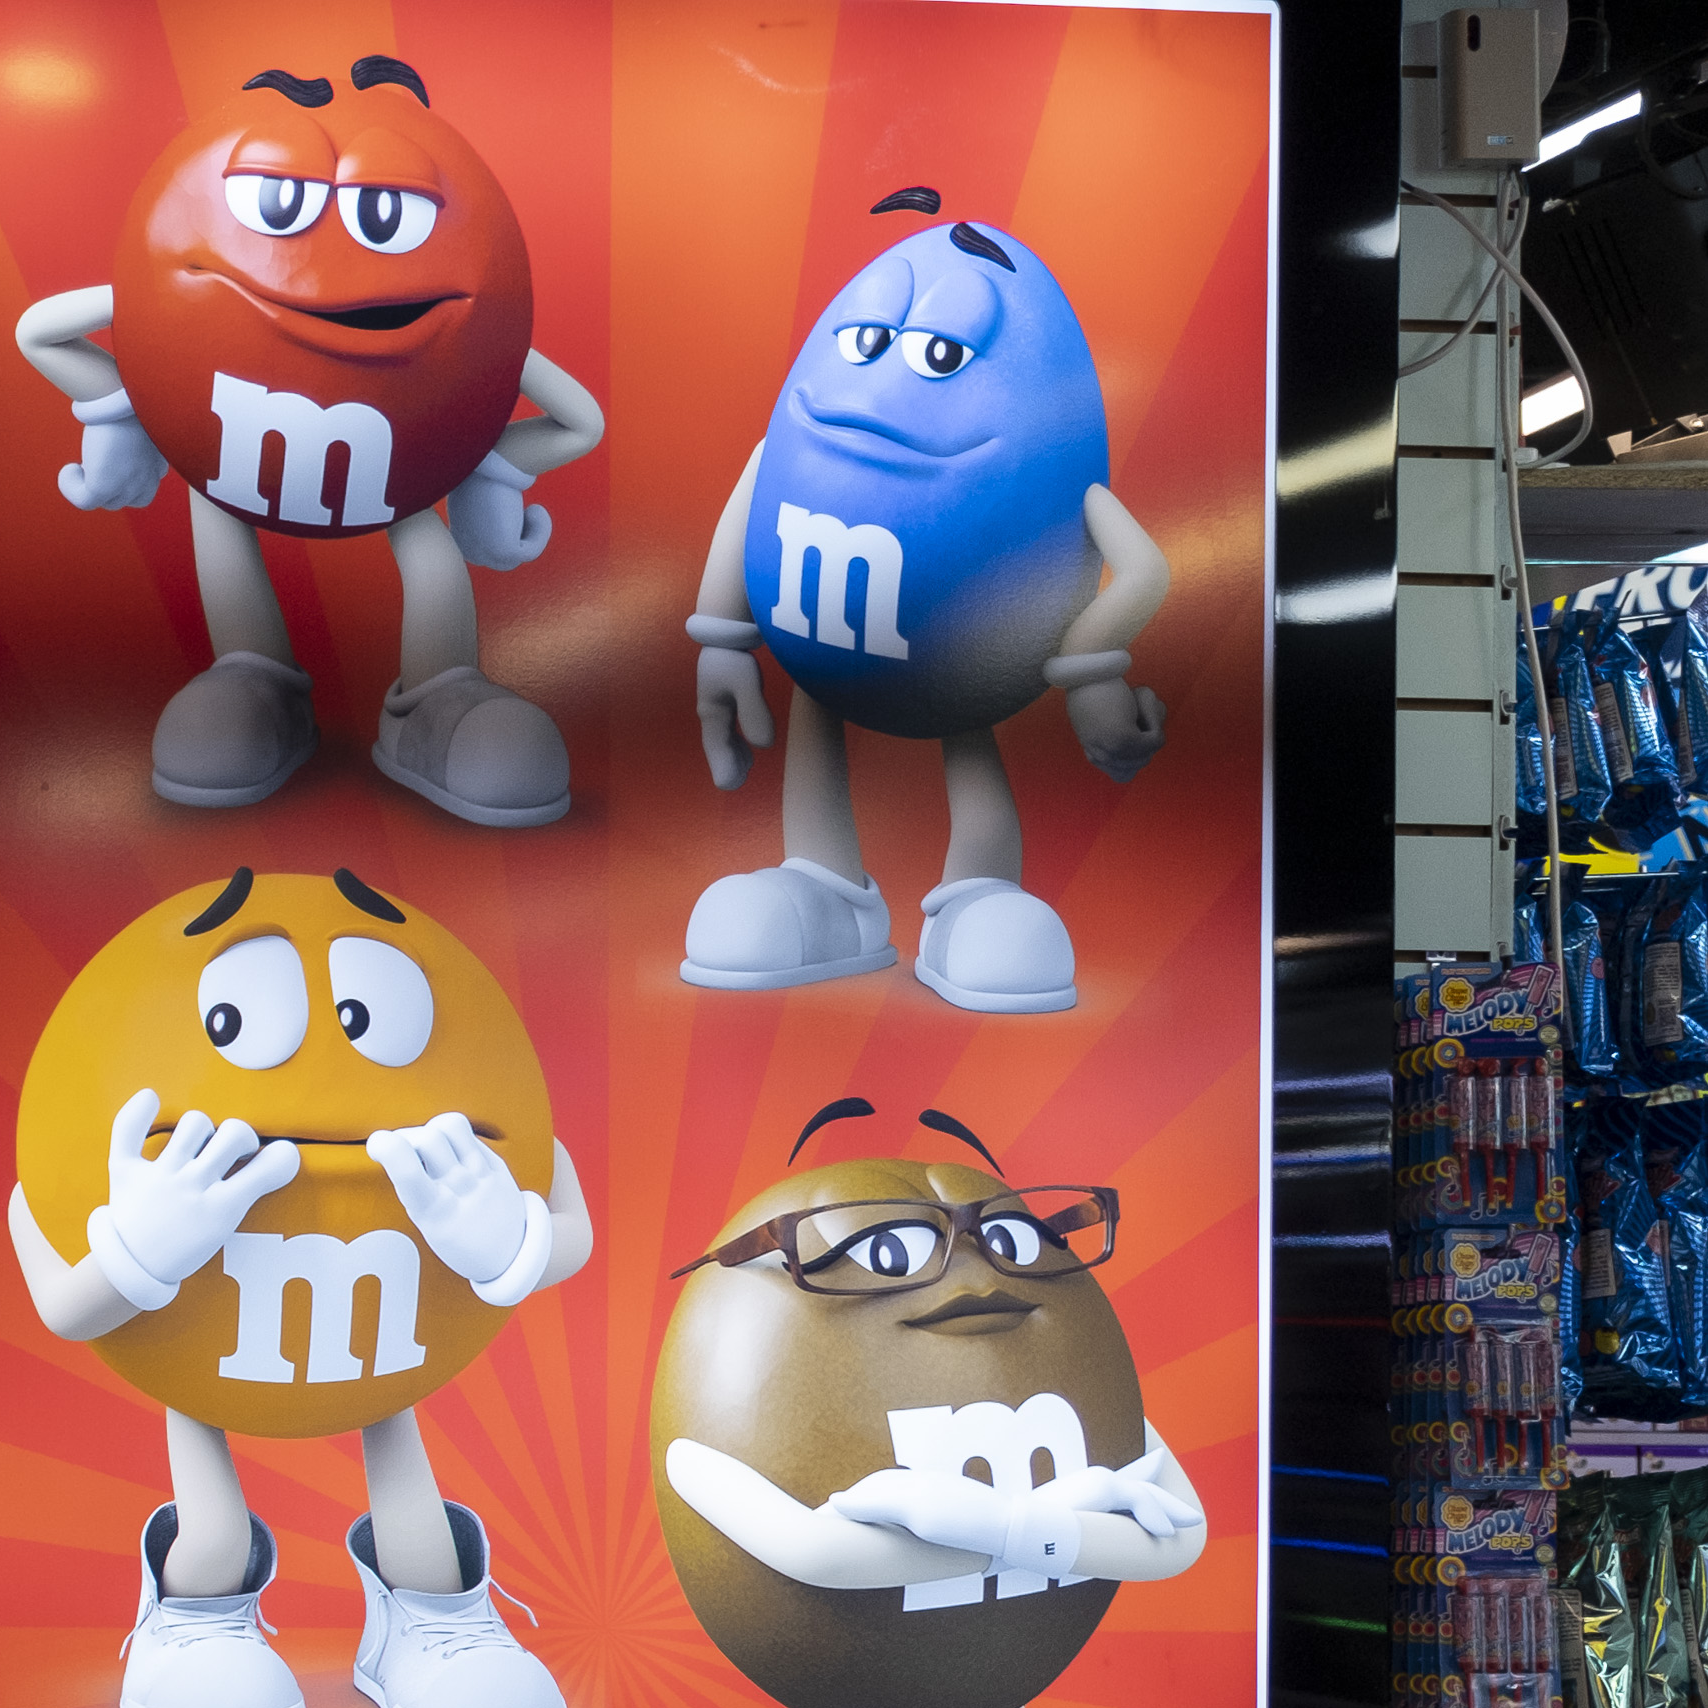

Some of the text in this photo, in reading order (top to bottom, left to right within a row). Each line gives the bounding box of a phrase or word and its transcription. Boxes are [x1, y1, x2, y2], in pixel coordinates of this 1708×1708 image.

[206, 369, 396, 528] m
[771, 500, 910, 663] m
[1445, 988, 1530, 1036] MELODY
[1491, 1016, 1535, 1031] POPS
[1454, 1257, 1529, 1301] MELODY
[1496, 1285, 1536, 1299] POPS
[218, 1228, 427, 1384] m
[1447, 1508, 1527, 1553] MELODY
[1490, 1535, 1533, 1549] POPS
